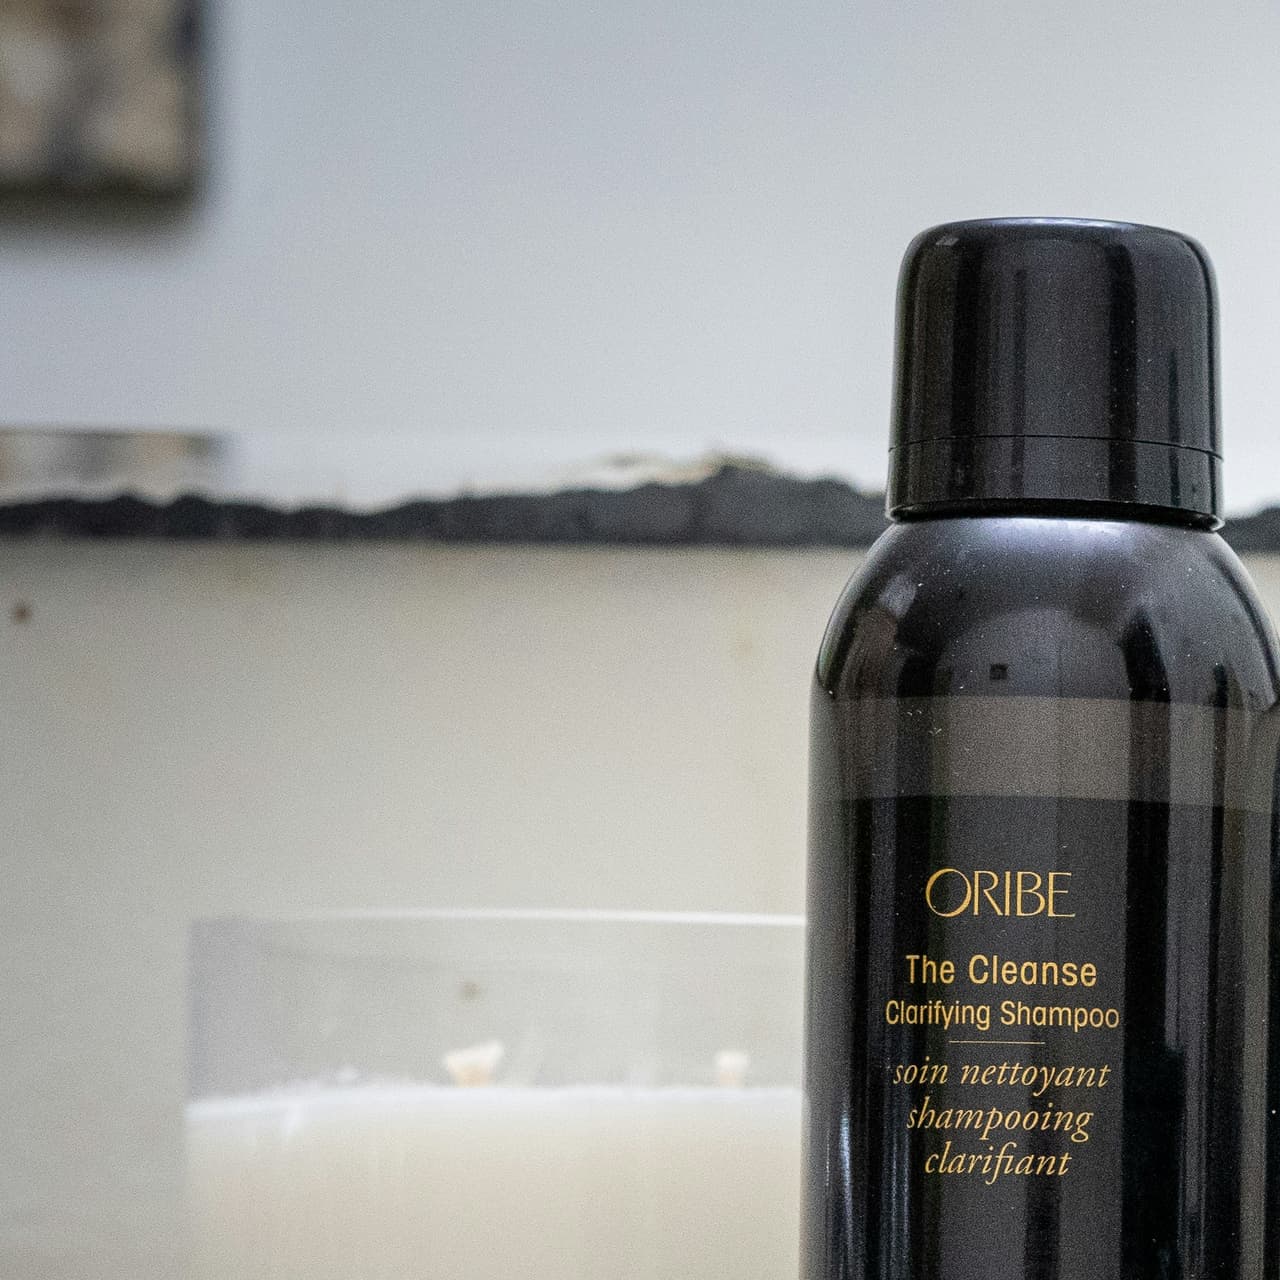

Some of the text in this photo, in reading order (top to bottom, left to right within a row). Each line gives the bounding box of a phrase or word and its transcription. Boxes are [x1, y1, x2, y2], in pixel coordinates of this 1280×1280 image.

[925, 868, 1075, 917] ORIBE
[906, 955, 1098, 987] The Cleanse
[885, 1000, 1120, 1032] Clarifying Shampoo
[893, 1056, 1111, 1097] soin nettoyant
[906, 1096, 1094, 1143] shampooing
[924, 1141, 1073, 1185] clarifiant
